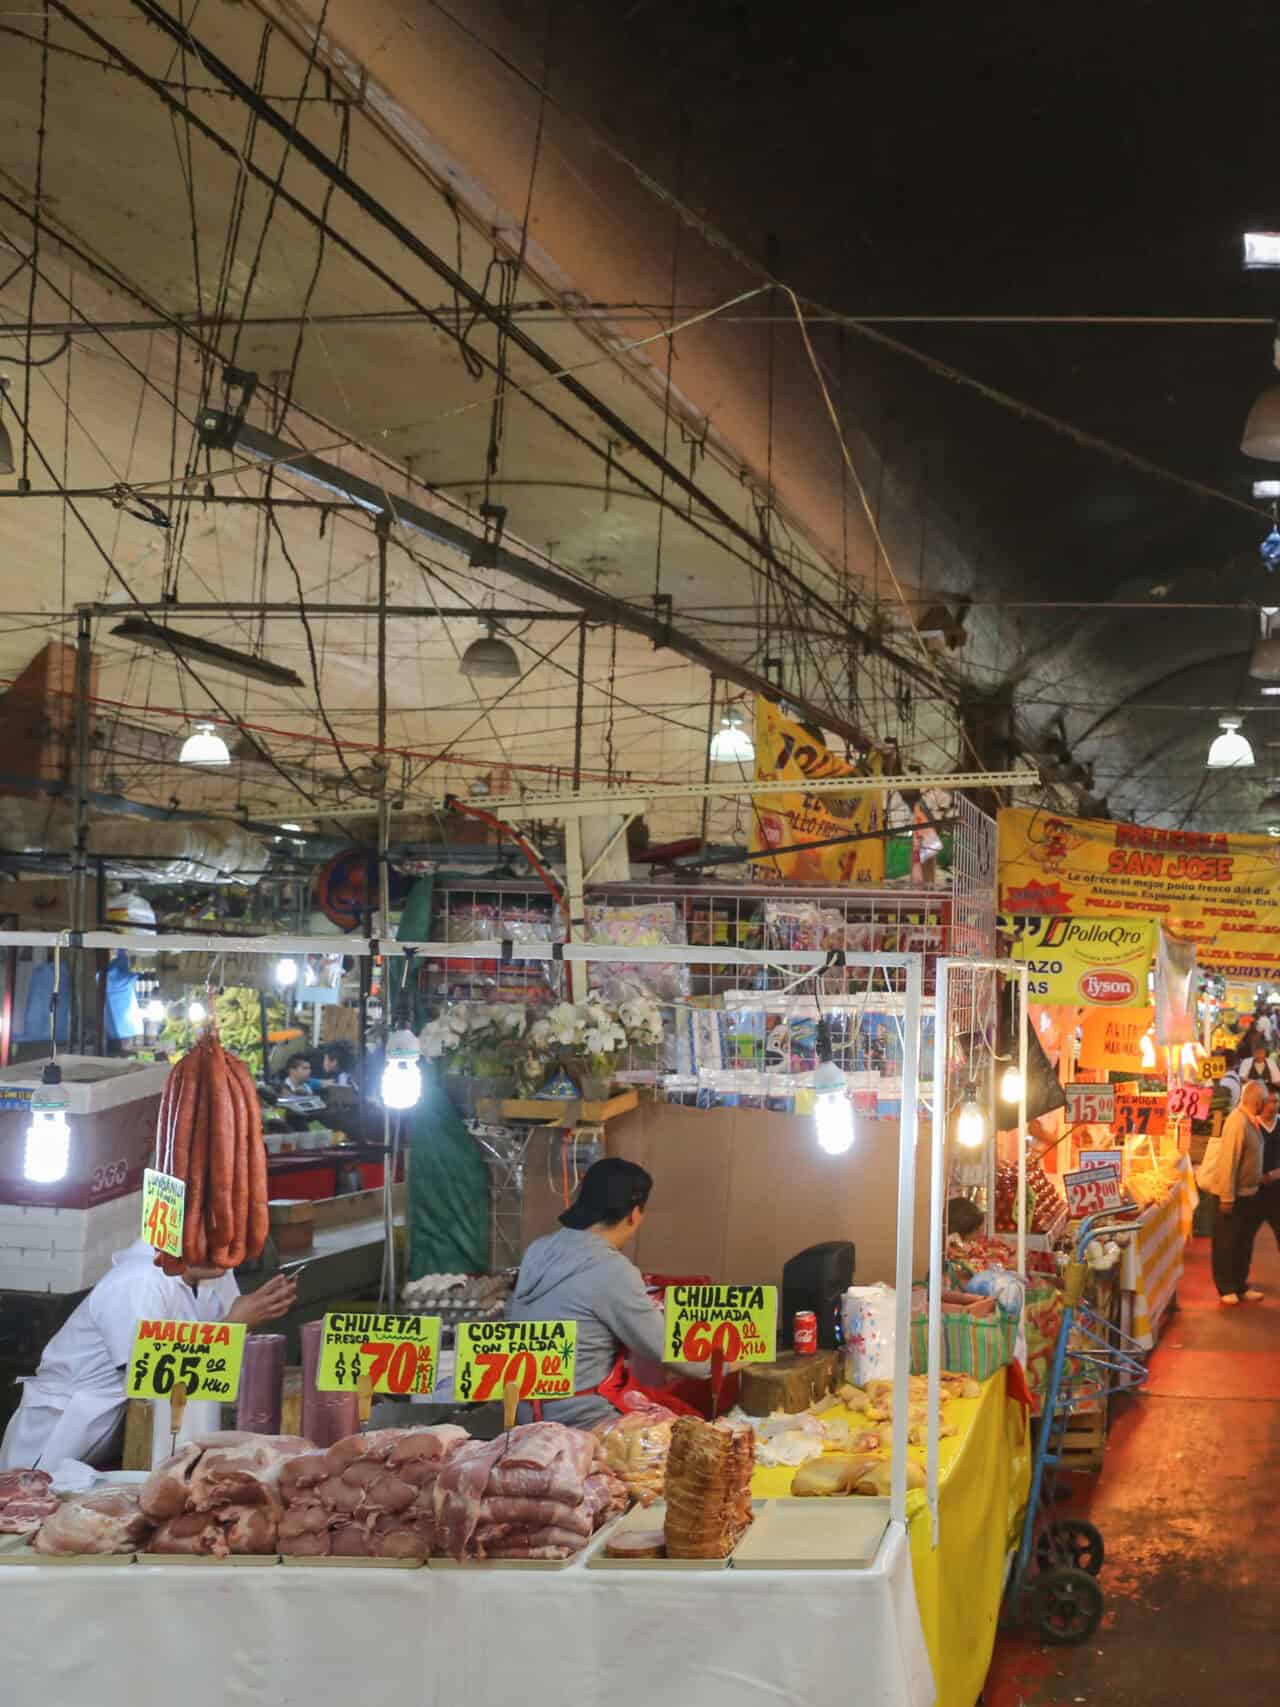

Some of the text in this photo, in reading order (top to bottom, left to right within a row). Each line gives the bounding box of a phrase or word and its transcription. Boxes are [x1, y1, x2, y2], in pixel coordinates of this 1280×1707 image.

[1108, 850, 1234, 882] SAN JOSE
[1167, 881, 1195, 892] pollo
[1198, 883, 1231, 895] fresco
[1085, 976, 1132, 998] Tyson
[1171, 1088, 1201, 1118] 38
[673, 1285, 765, 1311] CHULETA
[329, 1313, 422, 1336] CHULETA
[678, 1308, 753, 1323] AHUMADA
[138, 1320, 231, 1346] MACIZA
[325, 1333, 371, 1345] FRESCA
[468, 1323, 566, 1342] COSTILLA
[472, 1340, 559, 1355] CON FALDA
